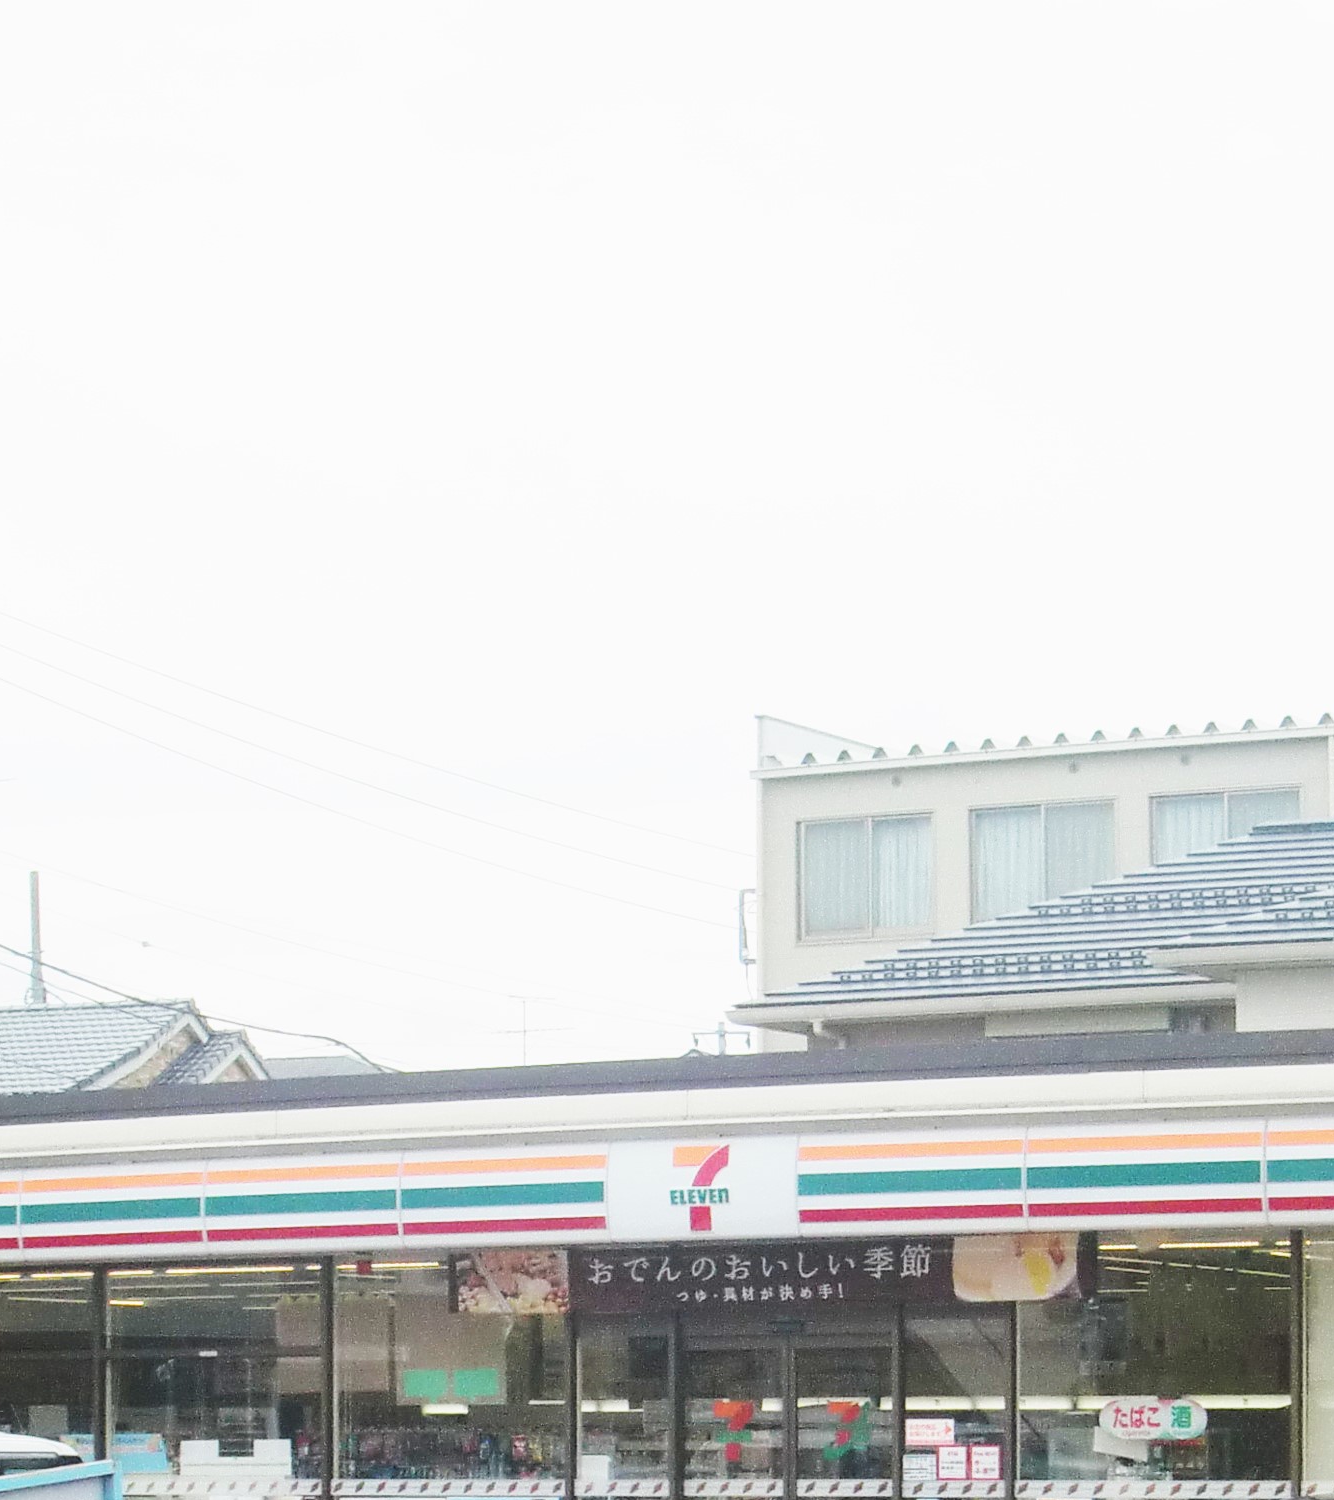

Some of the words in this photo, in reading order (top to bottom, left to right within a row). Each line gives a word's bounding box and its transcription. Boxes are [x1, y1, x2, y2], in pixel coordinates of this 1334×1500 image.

[587, 1243, 932, 1285] おでんのおいしい季節
[1113, 1405, 1161, 1428] たばこ
